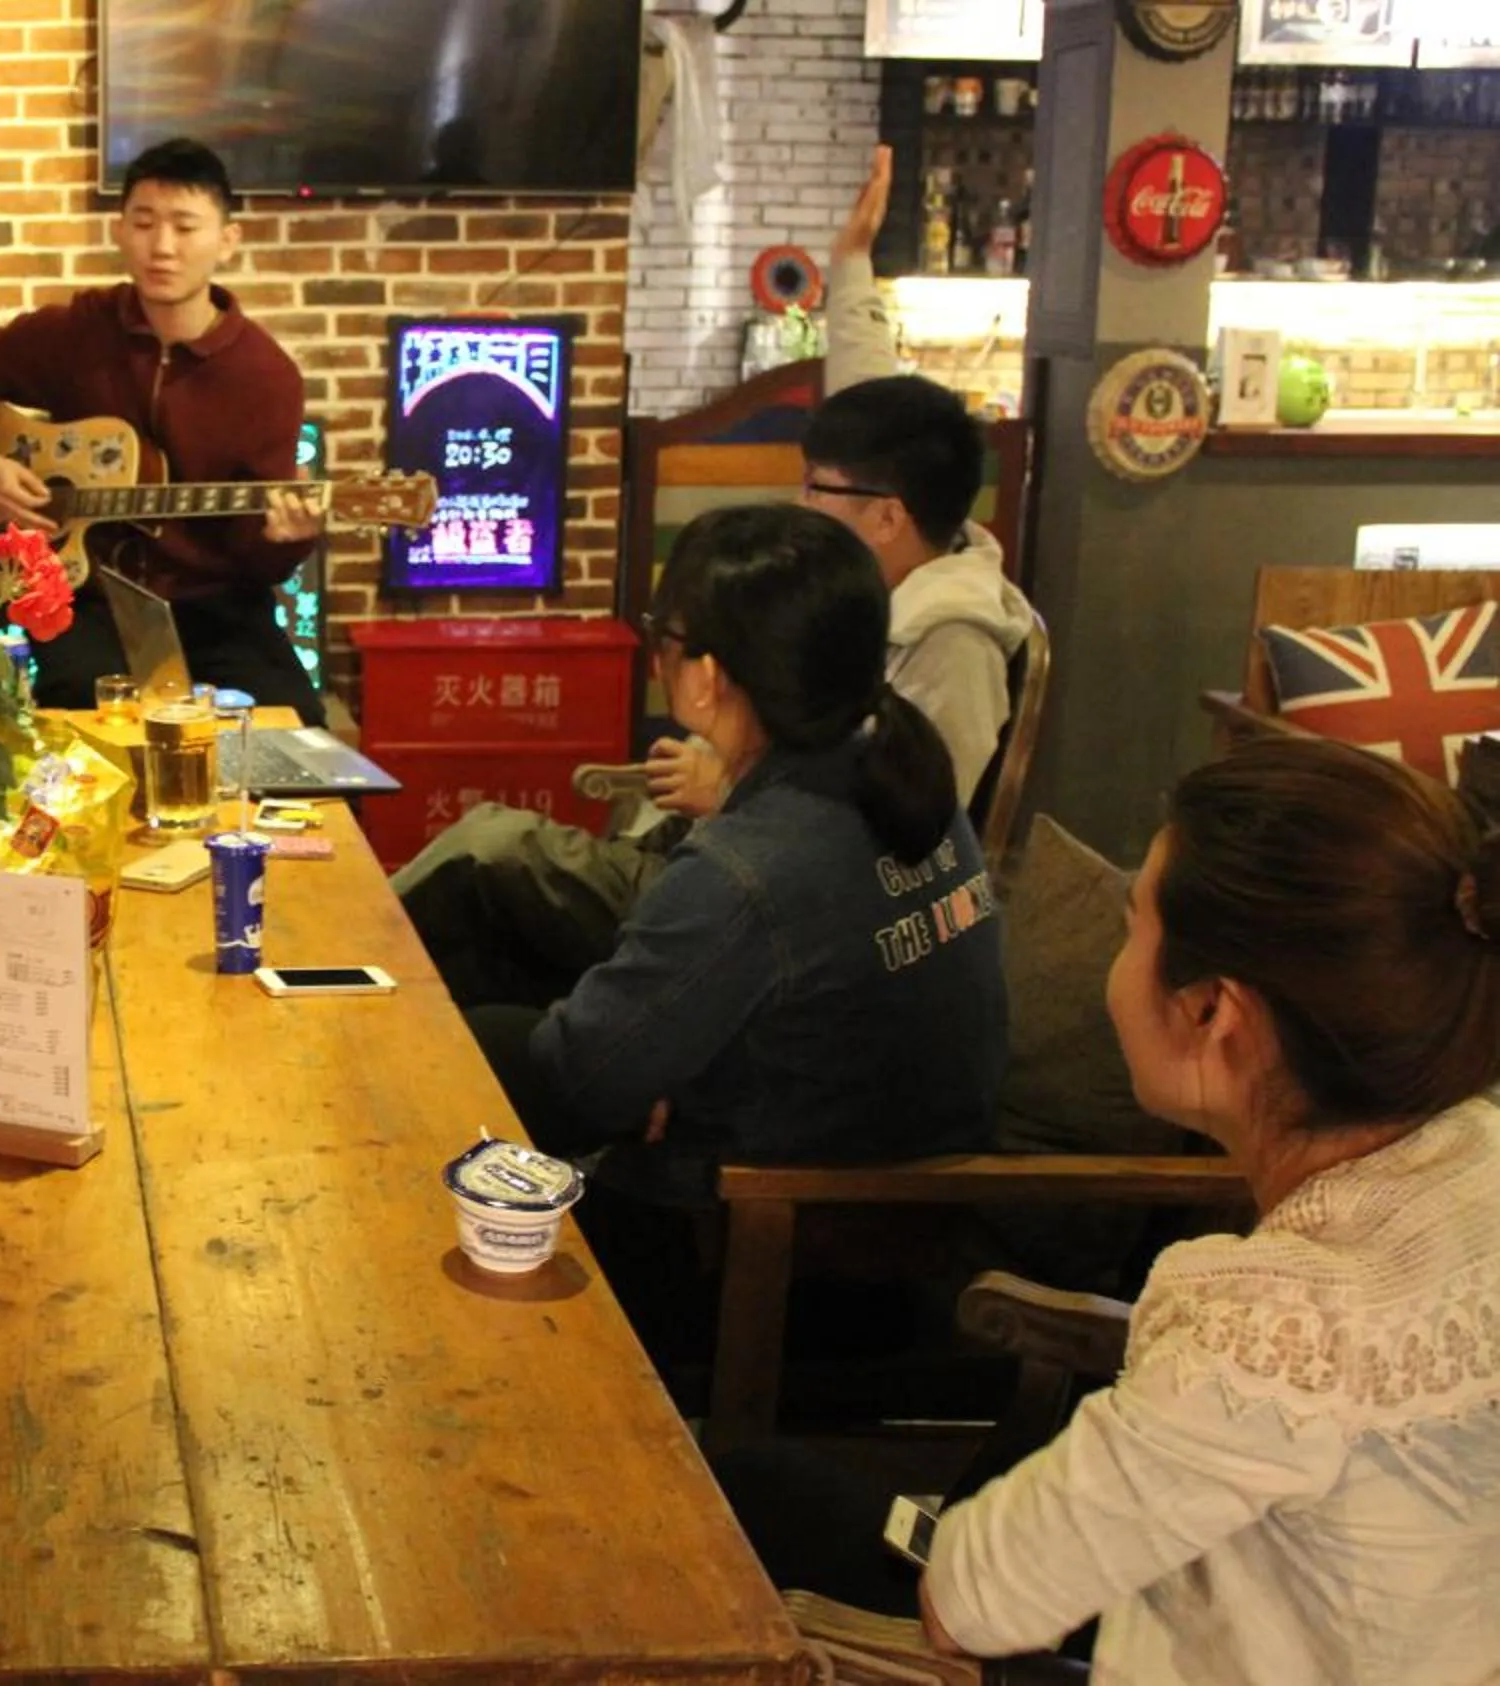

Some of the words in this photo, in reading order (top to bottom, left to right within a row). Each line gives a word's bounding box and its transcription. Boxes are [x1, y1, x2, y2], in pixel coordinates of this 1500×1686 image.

[445, 442, 513, 470] 20:30
[433, 673, 561, 708] 灭火器箱
[875, 911, 933, 972] THE
